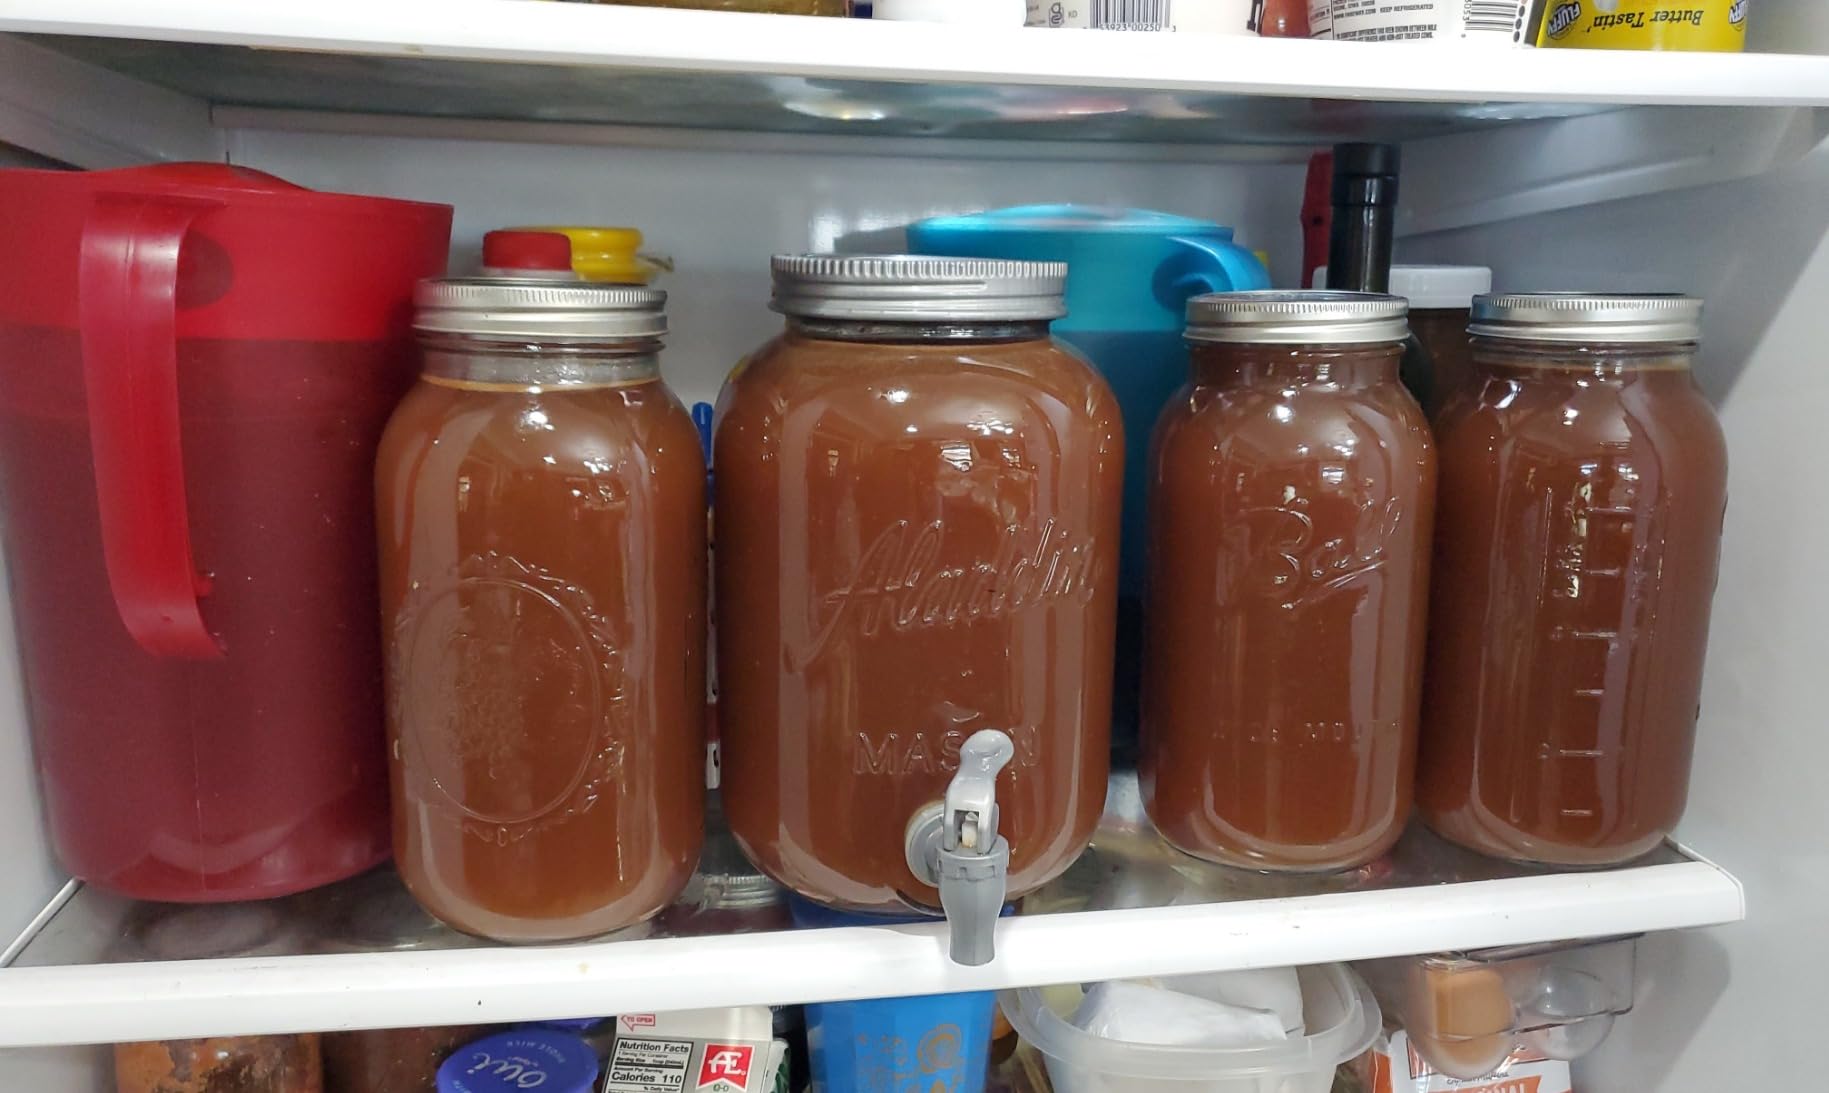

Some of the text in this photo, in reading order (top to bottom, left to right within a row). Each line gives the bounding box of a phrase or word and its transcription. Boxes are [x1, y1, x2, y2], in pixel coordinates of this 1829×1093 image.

[1548, 3, 1581, 36] FLUFFY
[1586, 10, 1704, 33] Butter Tastin'
[851, 730, 1041, 775] MASN
[619, 1041, 689, 1053] Nutrition Facts
[467, 1052, 548, 1089] Oui
[611, 1071, 682, 1084] Calories 110
